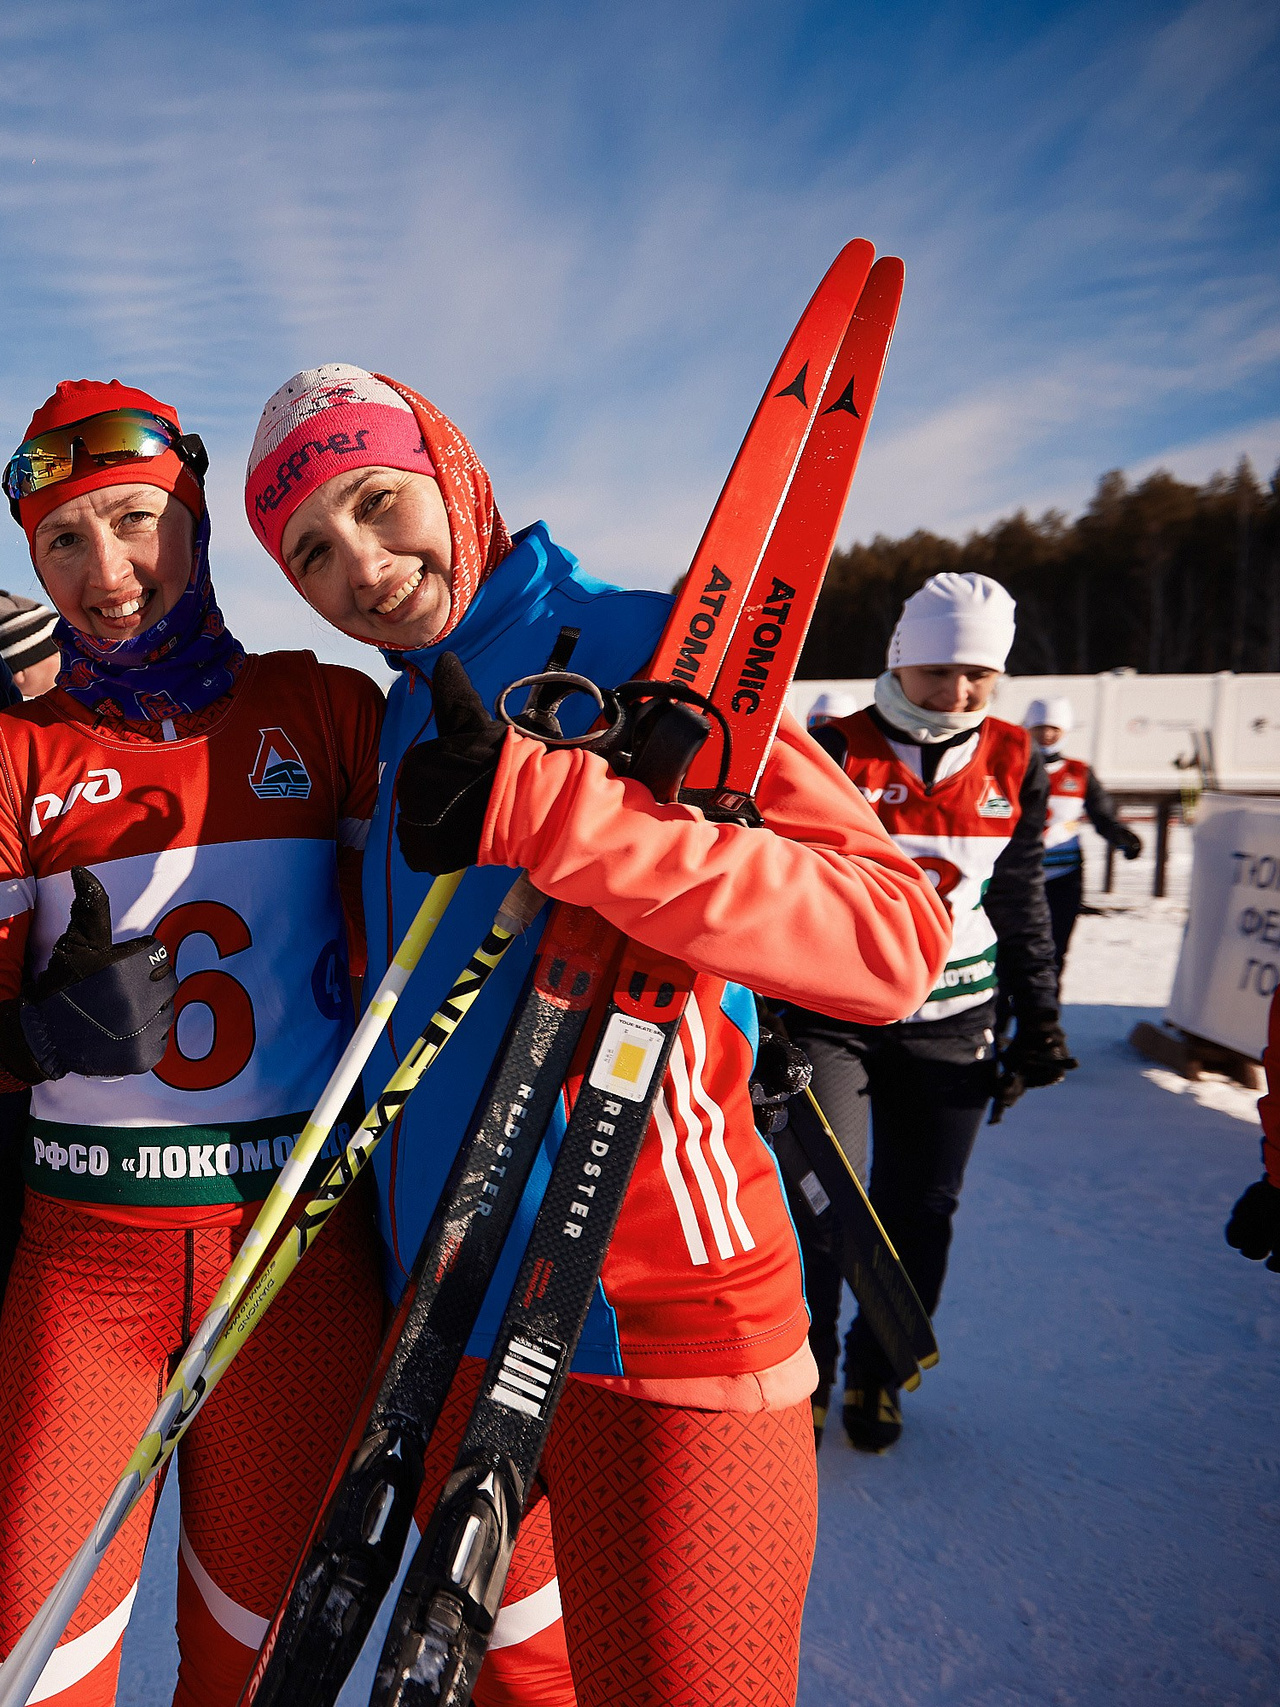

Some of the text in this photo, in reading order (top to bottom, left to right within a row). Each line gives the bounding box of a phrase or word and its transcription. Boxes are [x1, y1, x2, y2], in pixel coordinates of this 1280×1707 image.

[731, 576, 797, 715] ATOMIC
[151, 900, 256, 1091] 6
[324, 951, 341, 995] 4
[33, 1136, 110, 1176] РФСО
[476, 1082, 536, 1219] REDSTER
[563, 1099, 623, 1240] REDSTER
[238, 1279, 275, 1334] DIAMOND
